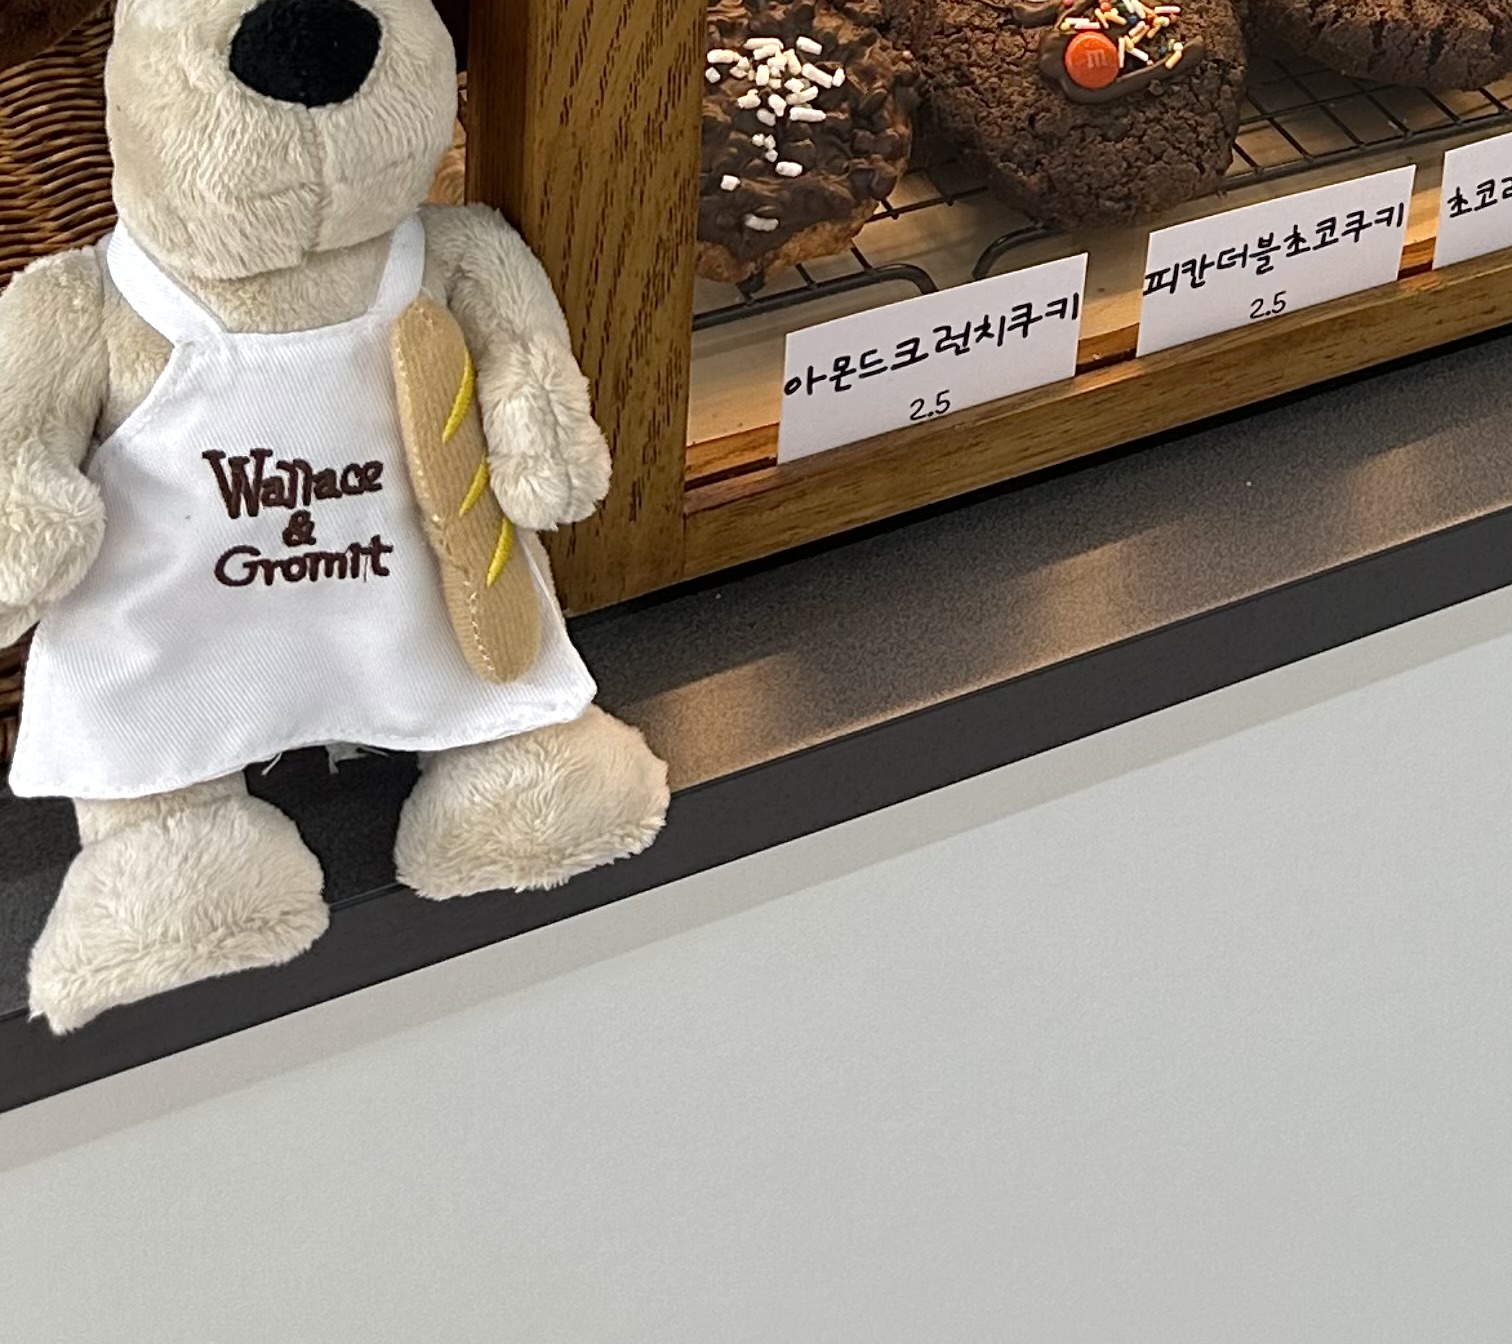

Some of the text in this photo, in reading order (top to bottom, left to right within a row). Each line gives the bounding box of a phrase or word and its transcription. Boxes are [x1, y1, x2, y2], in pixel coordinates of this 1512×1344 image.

[1143, 202, 1405, 296] 피칸더블초코쿠키
[1250, 290, 1287, 319] 2.5
[784, 292, 1079, 395] 아몬드크런치쿠키
[909, 389, 951, 420] 2.5
[202, 448, 384, 519] Wallace
[282, 510, 317, 547] &
[214, 535, 393, 587] Gromit
